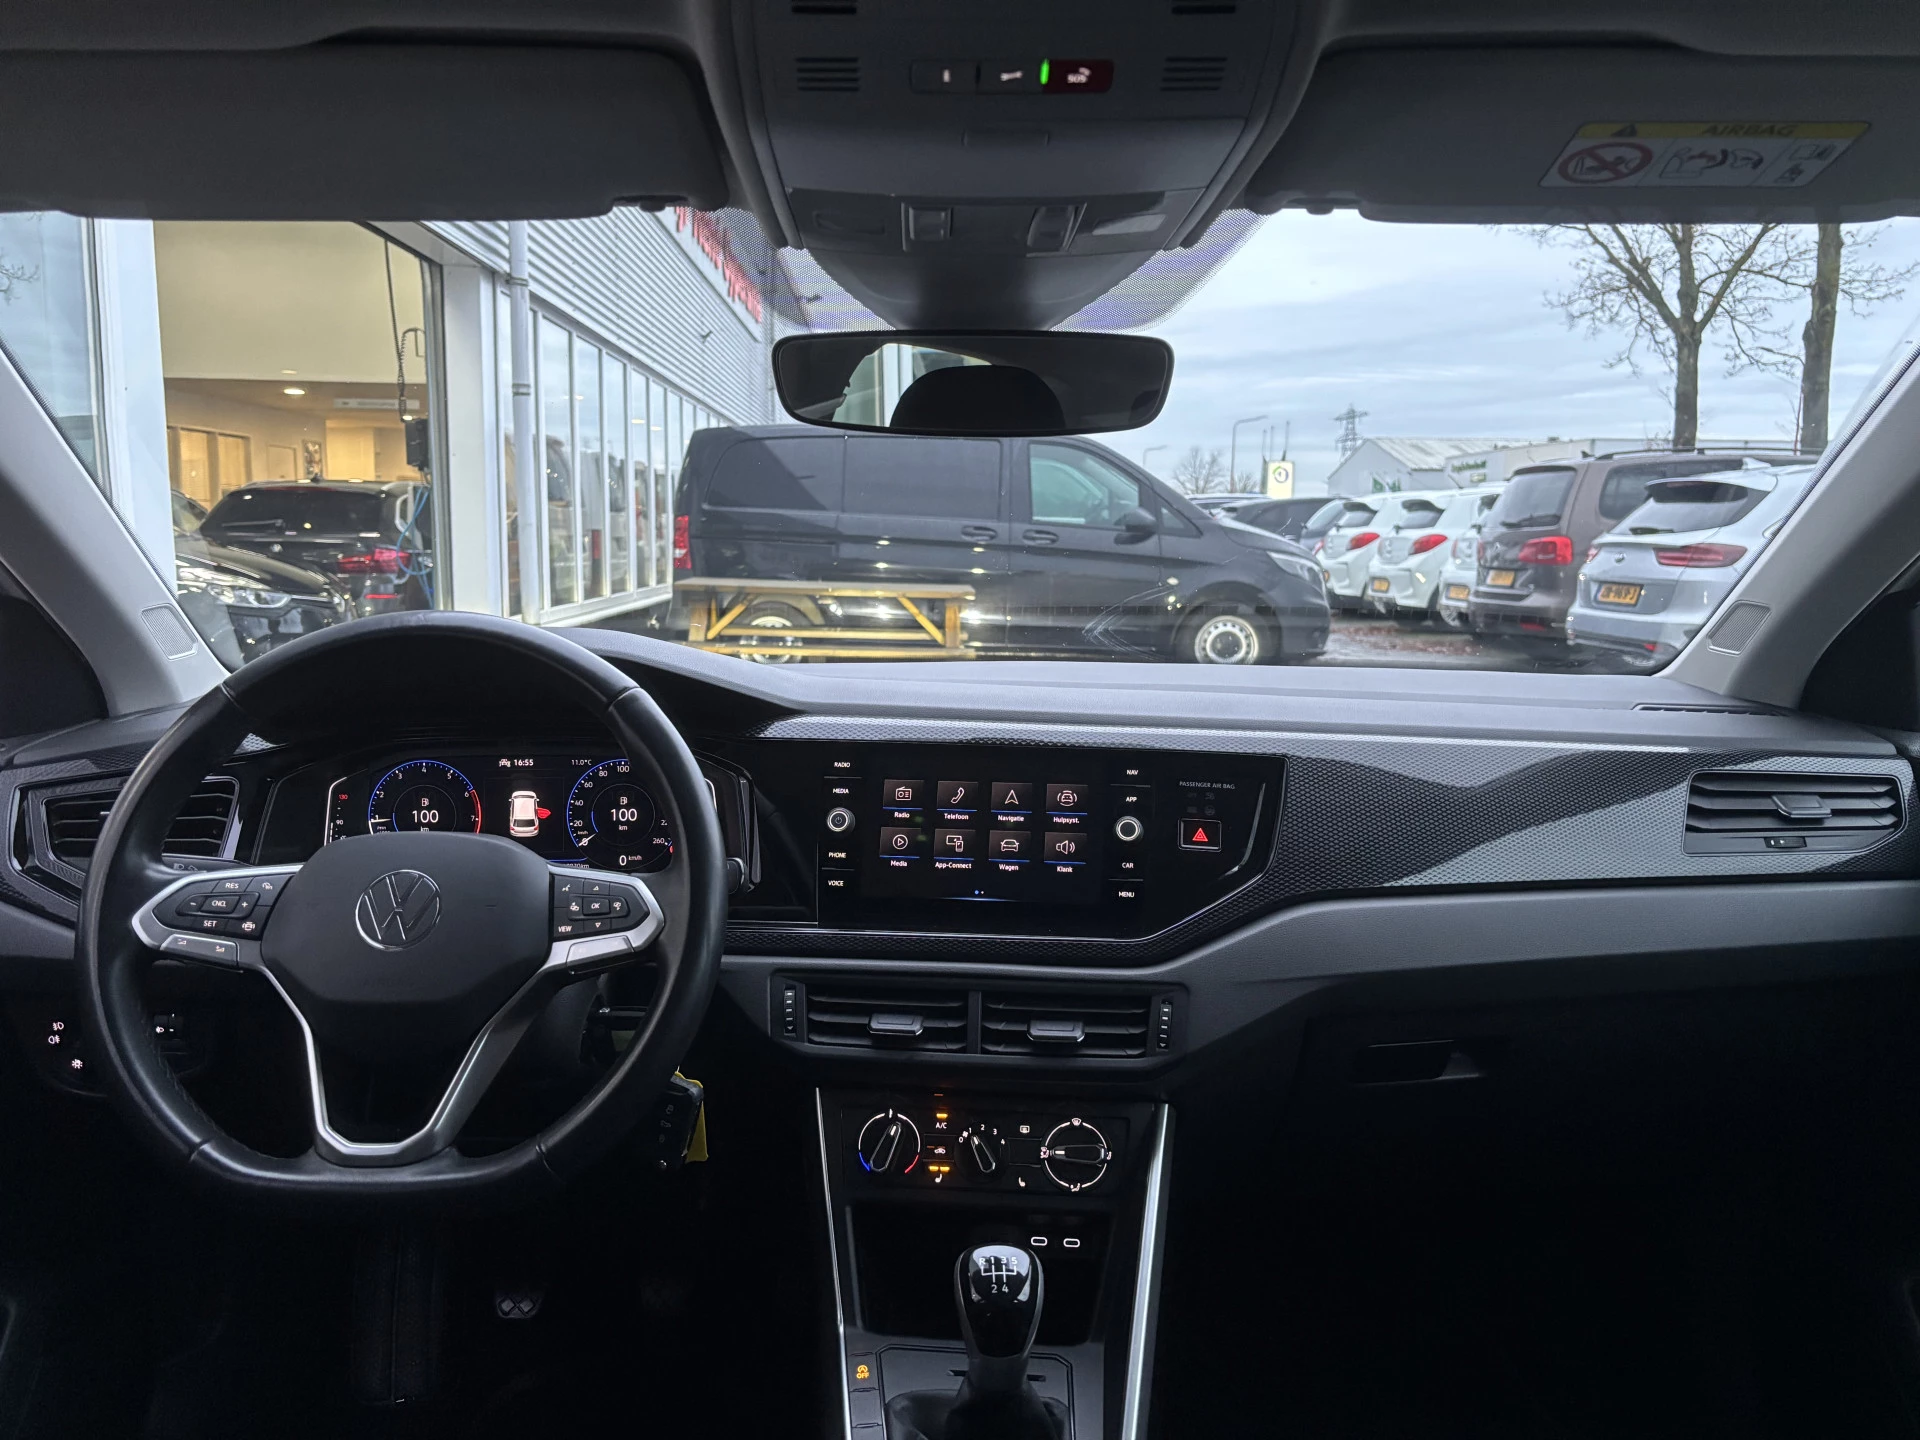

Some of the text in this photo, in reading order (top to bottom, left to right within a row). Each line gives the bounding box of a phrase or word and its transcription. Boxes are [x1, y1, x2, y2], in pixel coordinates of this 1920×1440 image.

[1067, 73, 1088, 83] SOS
[1701, 124, 1797, 136] AIRBAG
[616, 765, 630, 773] 100
[1179, 780, 1211, 788] PASSENGER
[412, 810, 439, 823] 100
[610, 808, 638, 821] 100
[944, 812, 969, 820] Telefoon
[997, 814, 1025, 822] Navigatie
[1053, 816, 1080, 824] Hulpsyst.
[828, 851, 846, 859] PHONE
[619, 855, 627, 866] 0
[935, 861, 972, 869] App-Connect
[998, 863, 1019, 872] Wagen
[590, 902, 600, 910] OK
[203, 920, 217, 928] SET
[558, 925, 573, 933] VIEW
[979, 1256, 1018, 1265] R 1 3 5
[991, 1284, 1009, 1293] 2 4
[856, 1371, 870, 1379] OFF
